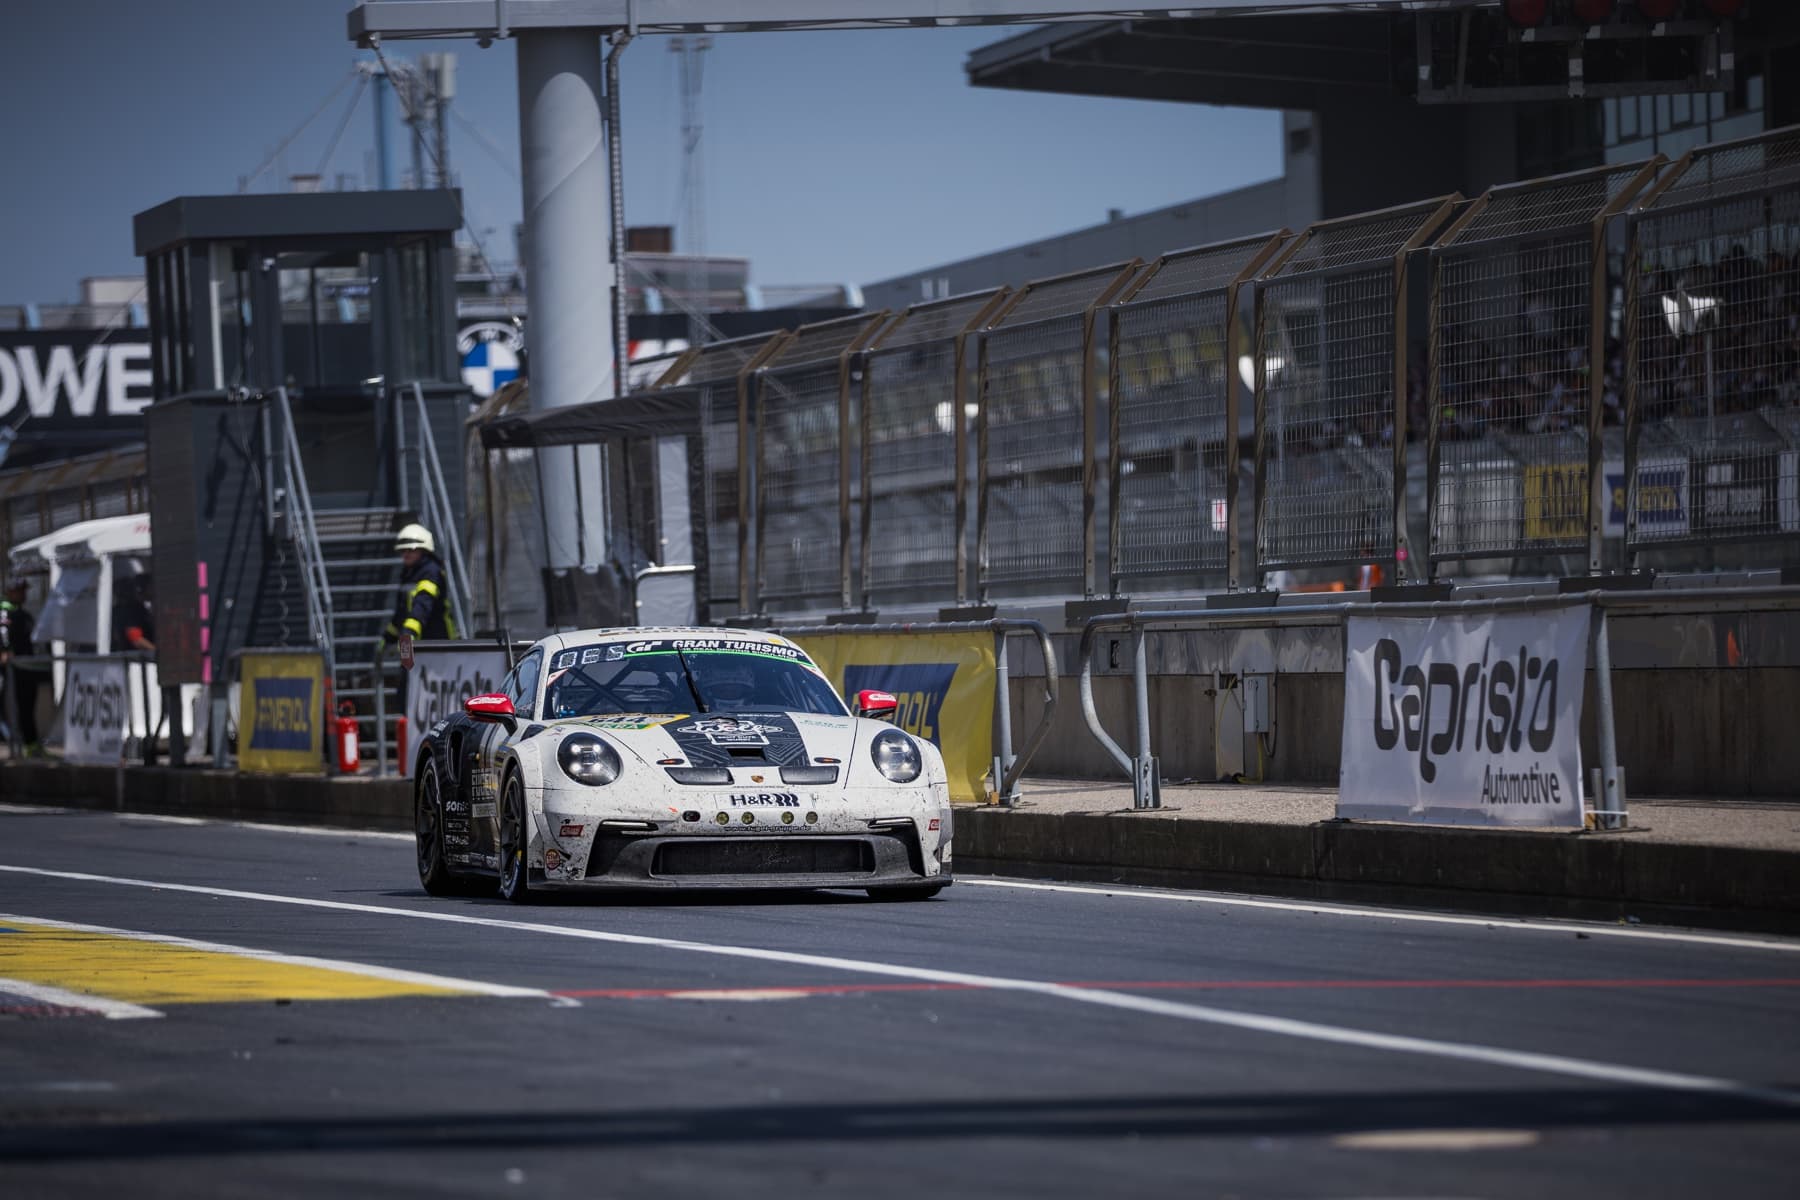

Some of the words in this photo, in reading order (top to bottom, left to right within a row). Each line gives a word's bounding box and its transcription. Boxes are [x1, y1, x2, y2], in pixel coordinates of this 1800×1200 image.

[672, 640, 720, 649] GRAN
[724, 641, 797, 658] TURISMO
[1374, 636, 1558, 783] Capristo
[1481, 761, 1561, 804] Automotive
[730, 793, 773, 806] H&R
